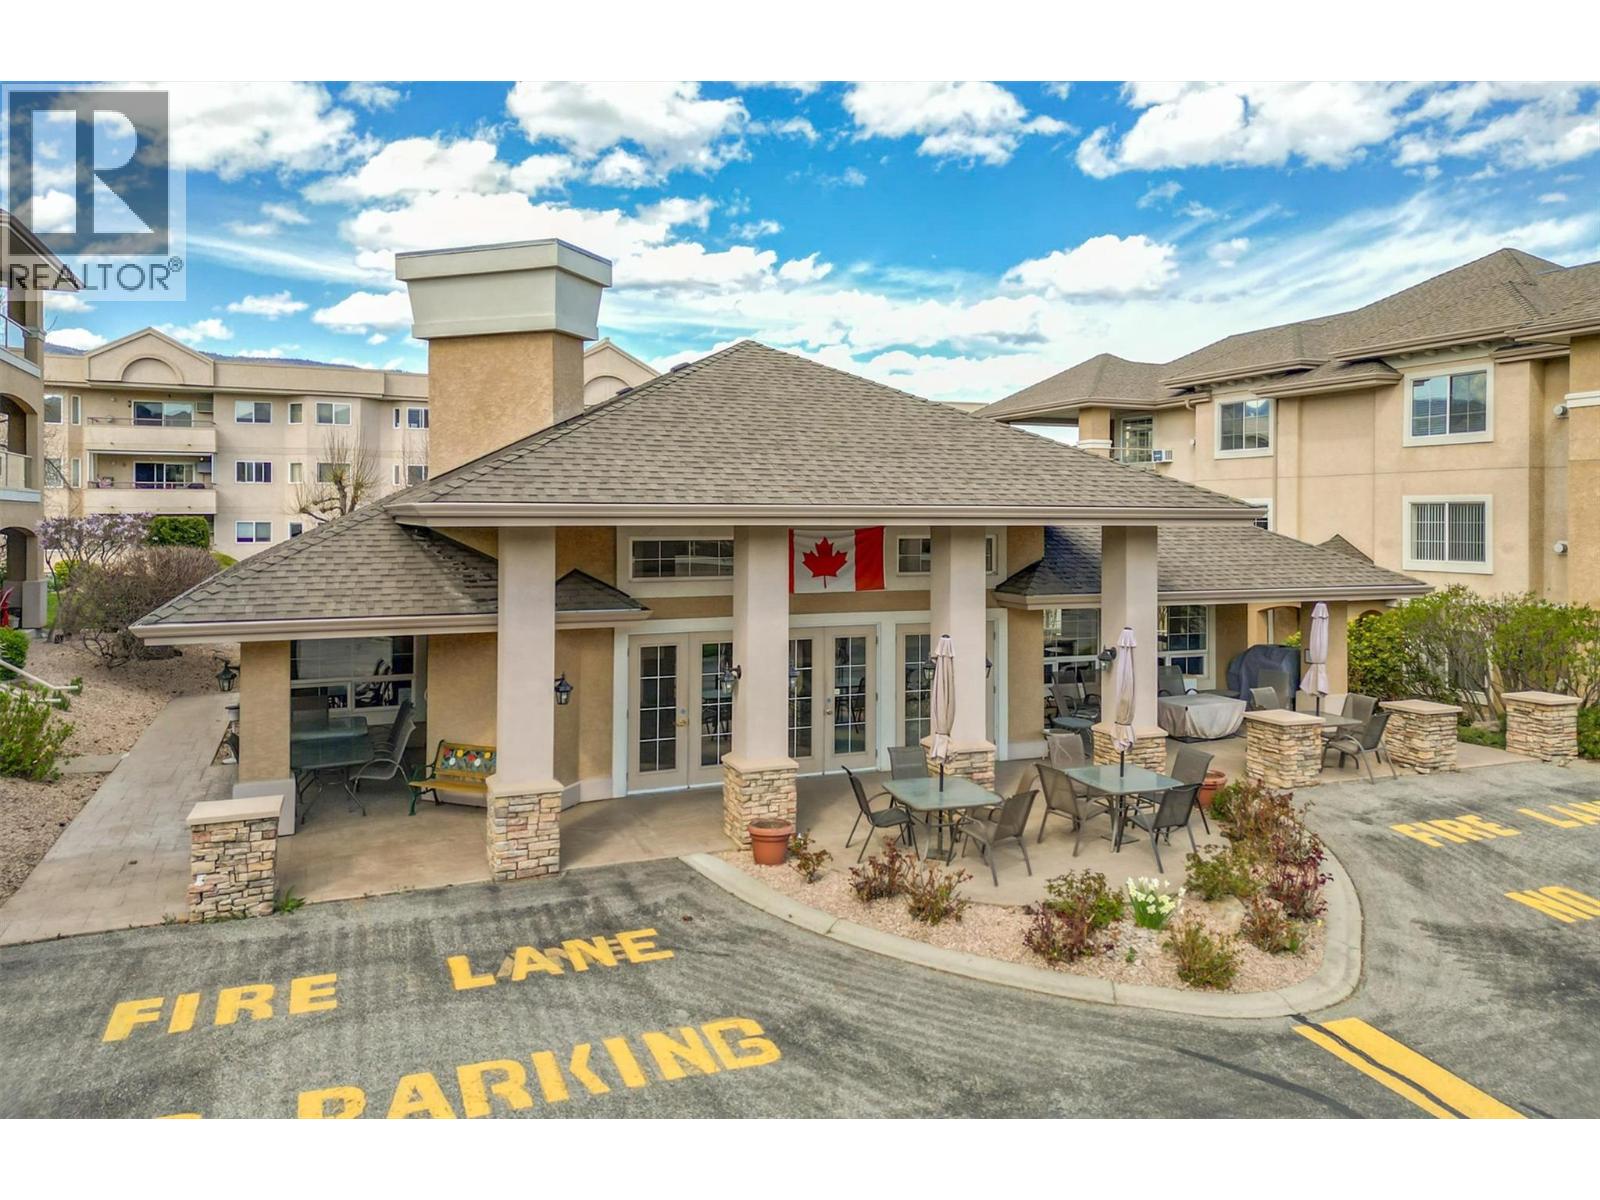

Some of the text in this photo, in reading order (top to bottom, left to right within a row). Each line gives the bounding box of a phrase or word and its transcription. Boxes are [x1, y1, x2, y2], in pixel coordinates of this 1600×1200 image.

[1390, 814, 1521, 848] FIRE
[102, 927, 675, 1042] FIRE LANE
[297, 1017, 782, 1119] PARKING
